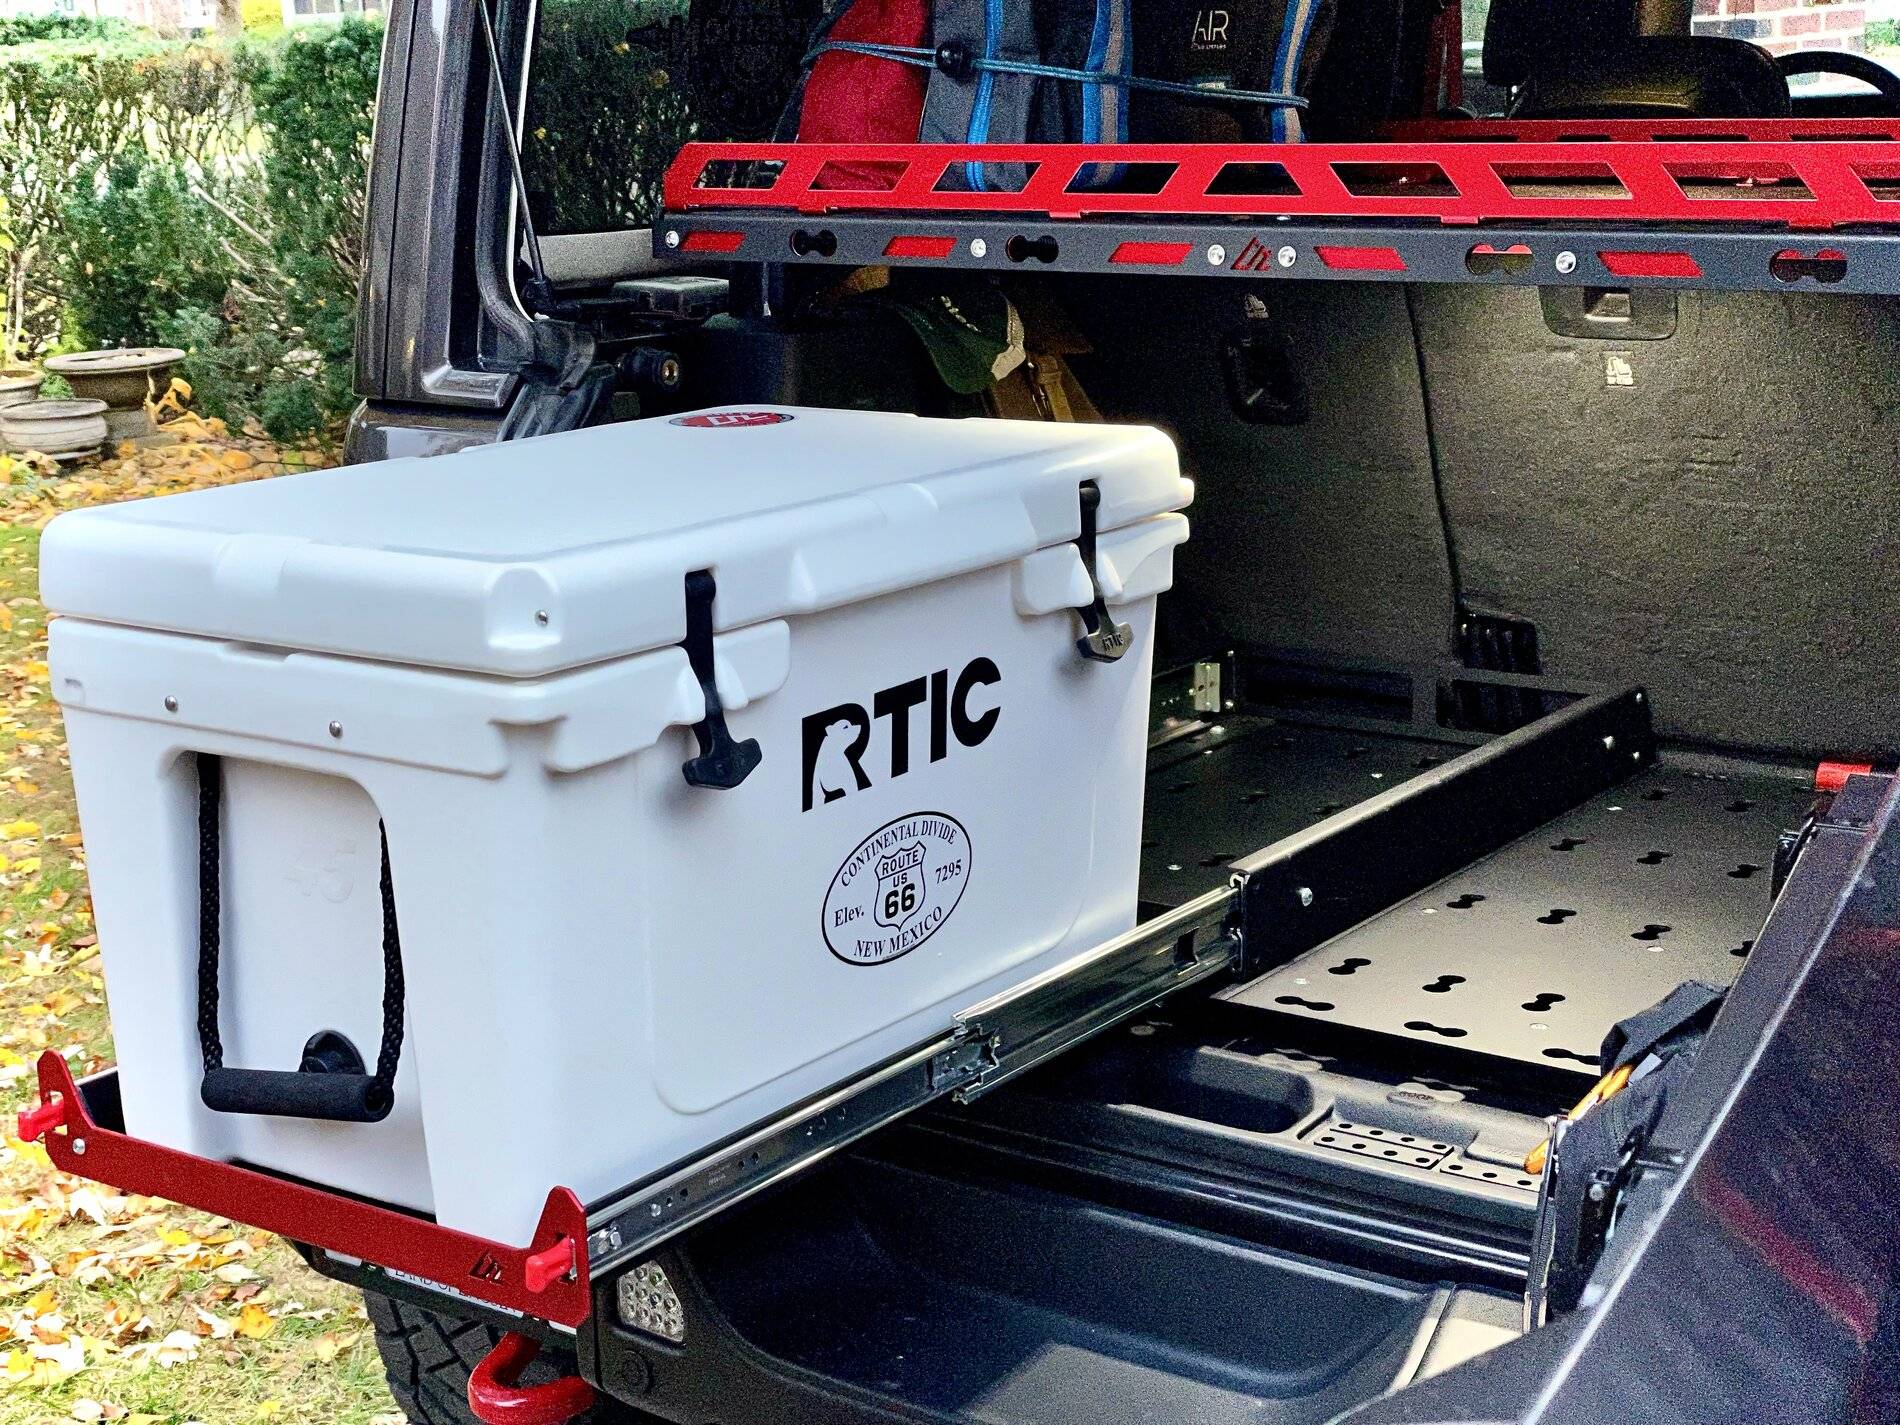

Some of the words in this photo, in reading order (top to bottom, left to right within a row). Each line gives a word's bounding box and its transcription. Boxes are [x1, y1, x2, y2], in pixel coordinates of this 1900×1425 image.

[801, 656, 1001, 812] RTIC
[841, 822, 918, 886] CONTINENTAL
[921, 821, 957, 844] DIVIDE
[882, 850, 919, 875] ROUTE
[893, 873, 907, 887] US
[936, 859, 961, 884] 7295
[885, 883, 915, 919] 66
[834, 906, 864, 927] Elev.
[854, 939, 886, 957] NEW
[889, 906, 942, 953] MEXICO
